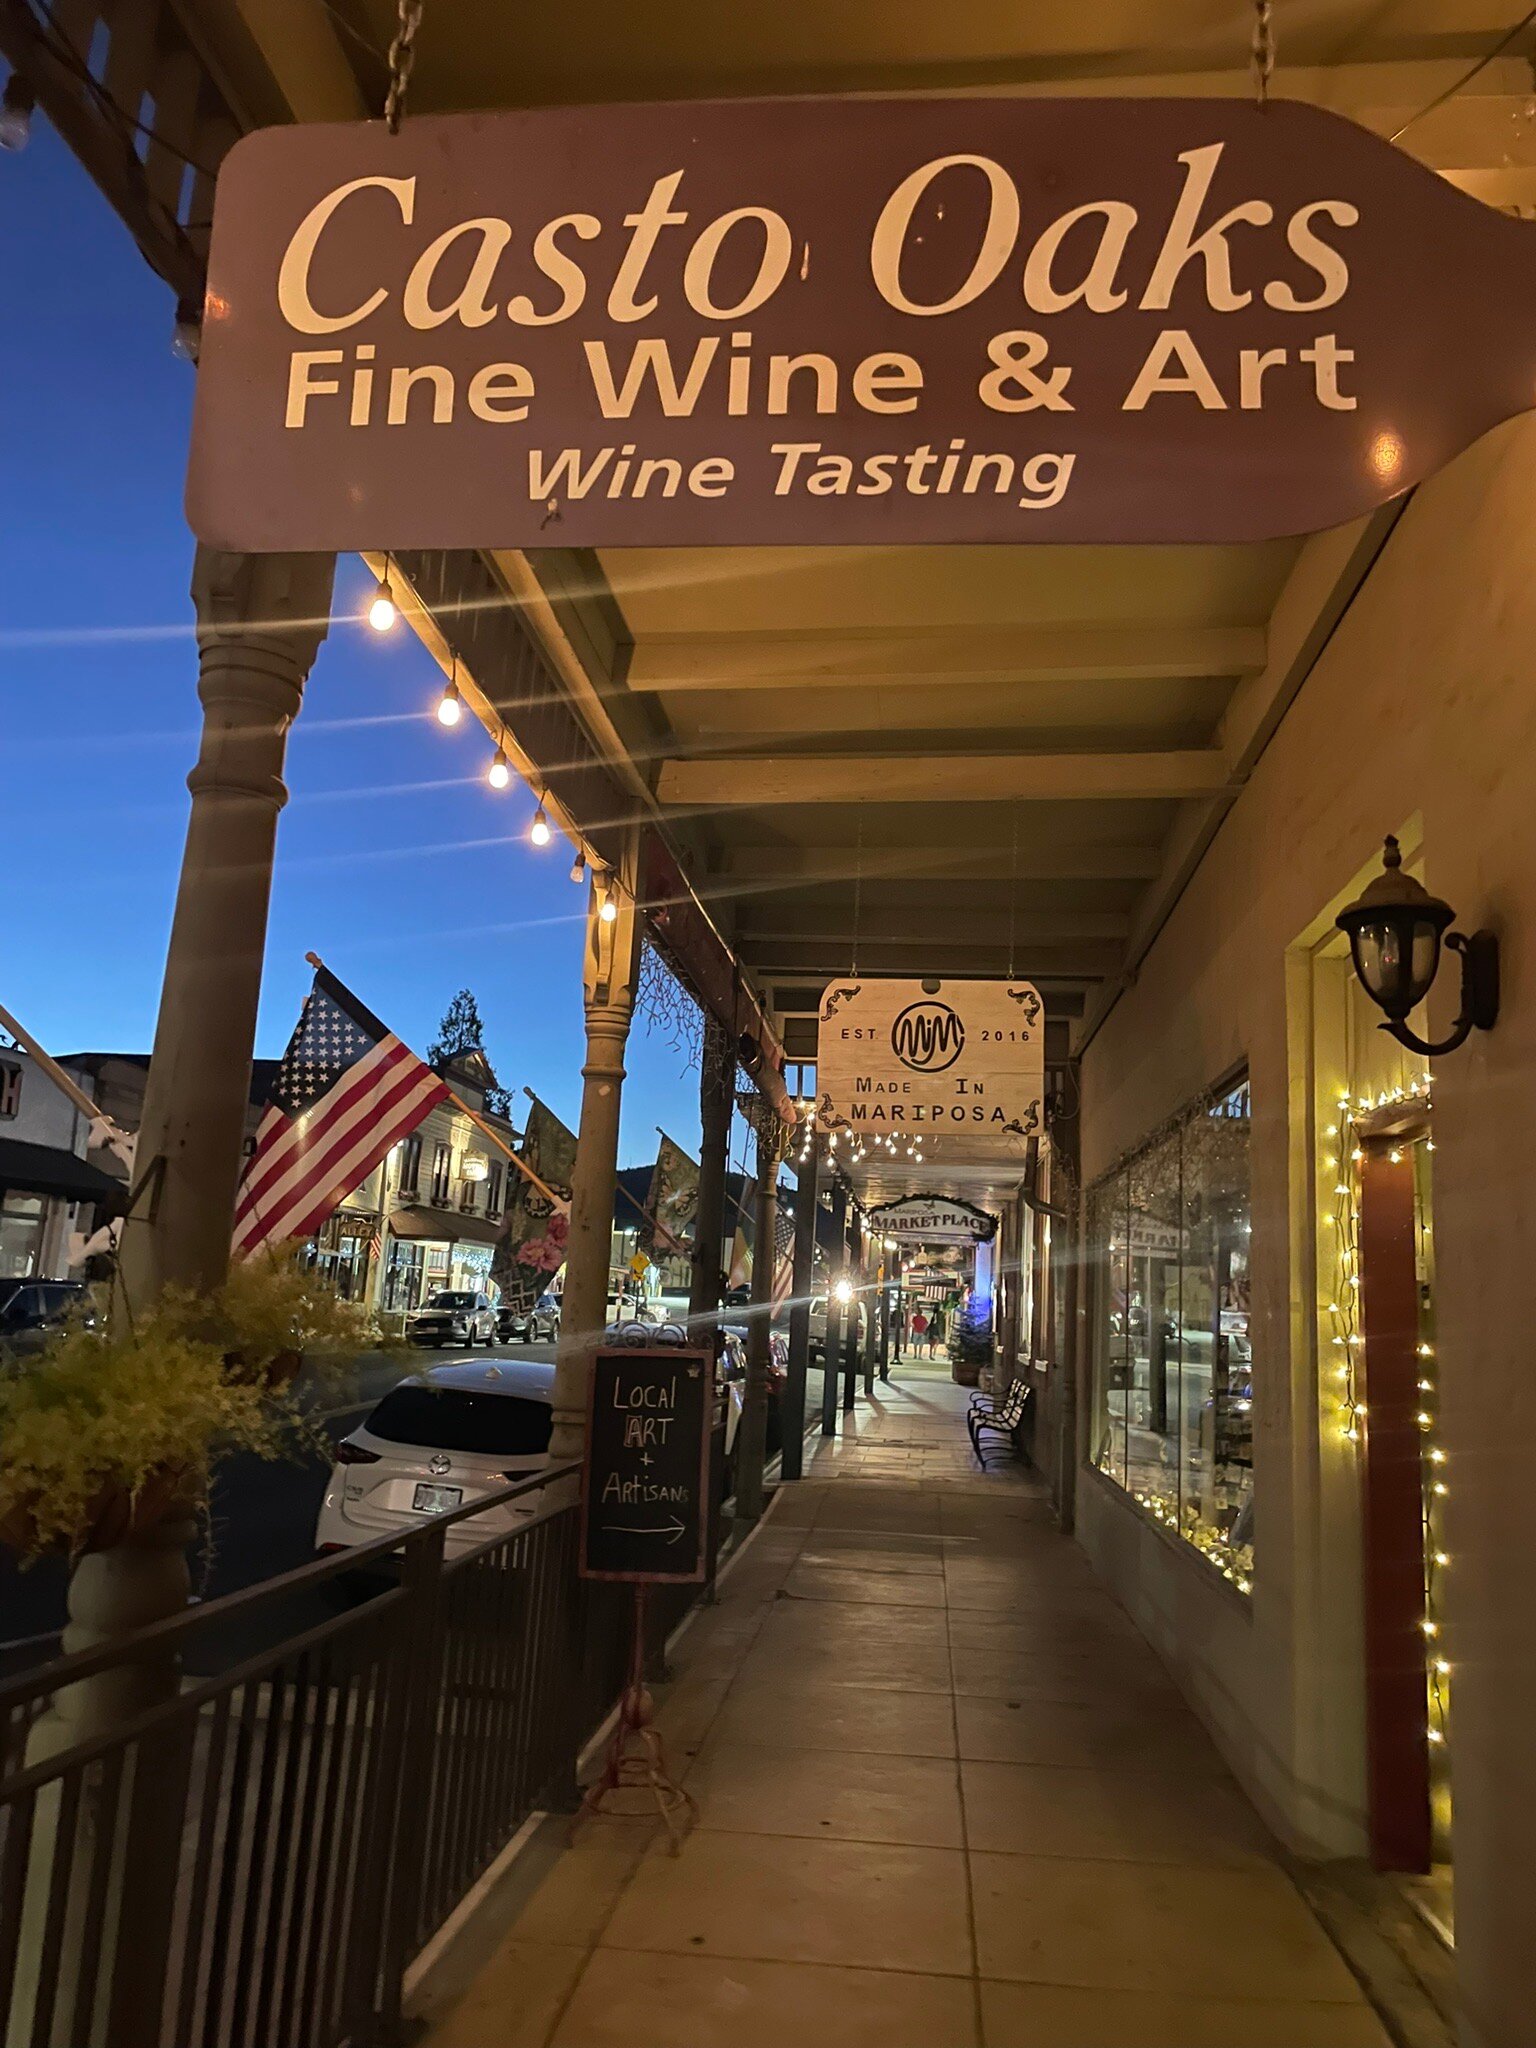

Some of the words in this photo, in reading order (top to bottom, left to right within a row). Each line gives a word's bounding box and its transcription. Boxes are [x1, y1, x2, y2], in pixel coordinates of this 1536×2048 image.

[278, 169, 792, 334] Casto
[871, 142, 1359, 316] Oaks
[285, 344, 535, 428] Fine
[583, 331, 924, 419] Wine
[978, 330, 1076, 413] &
[1122, 330, 1357, 411] Art
[528, 444, 735, 500] Wine
[770, 438, 1076, 509] Tasting
[981, 1030, 1030, 1042] 2016
[851, 1103, 1006, 1122] MARIPOSA
[623, 1414, 674, 1448] ART
